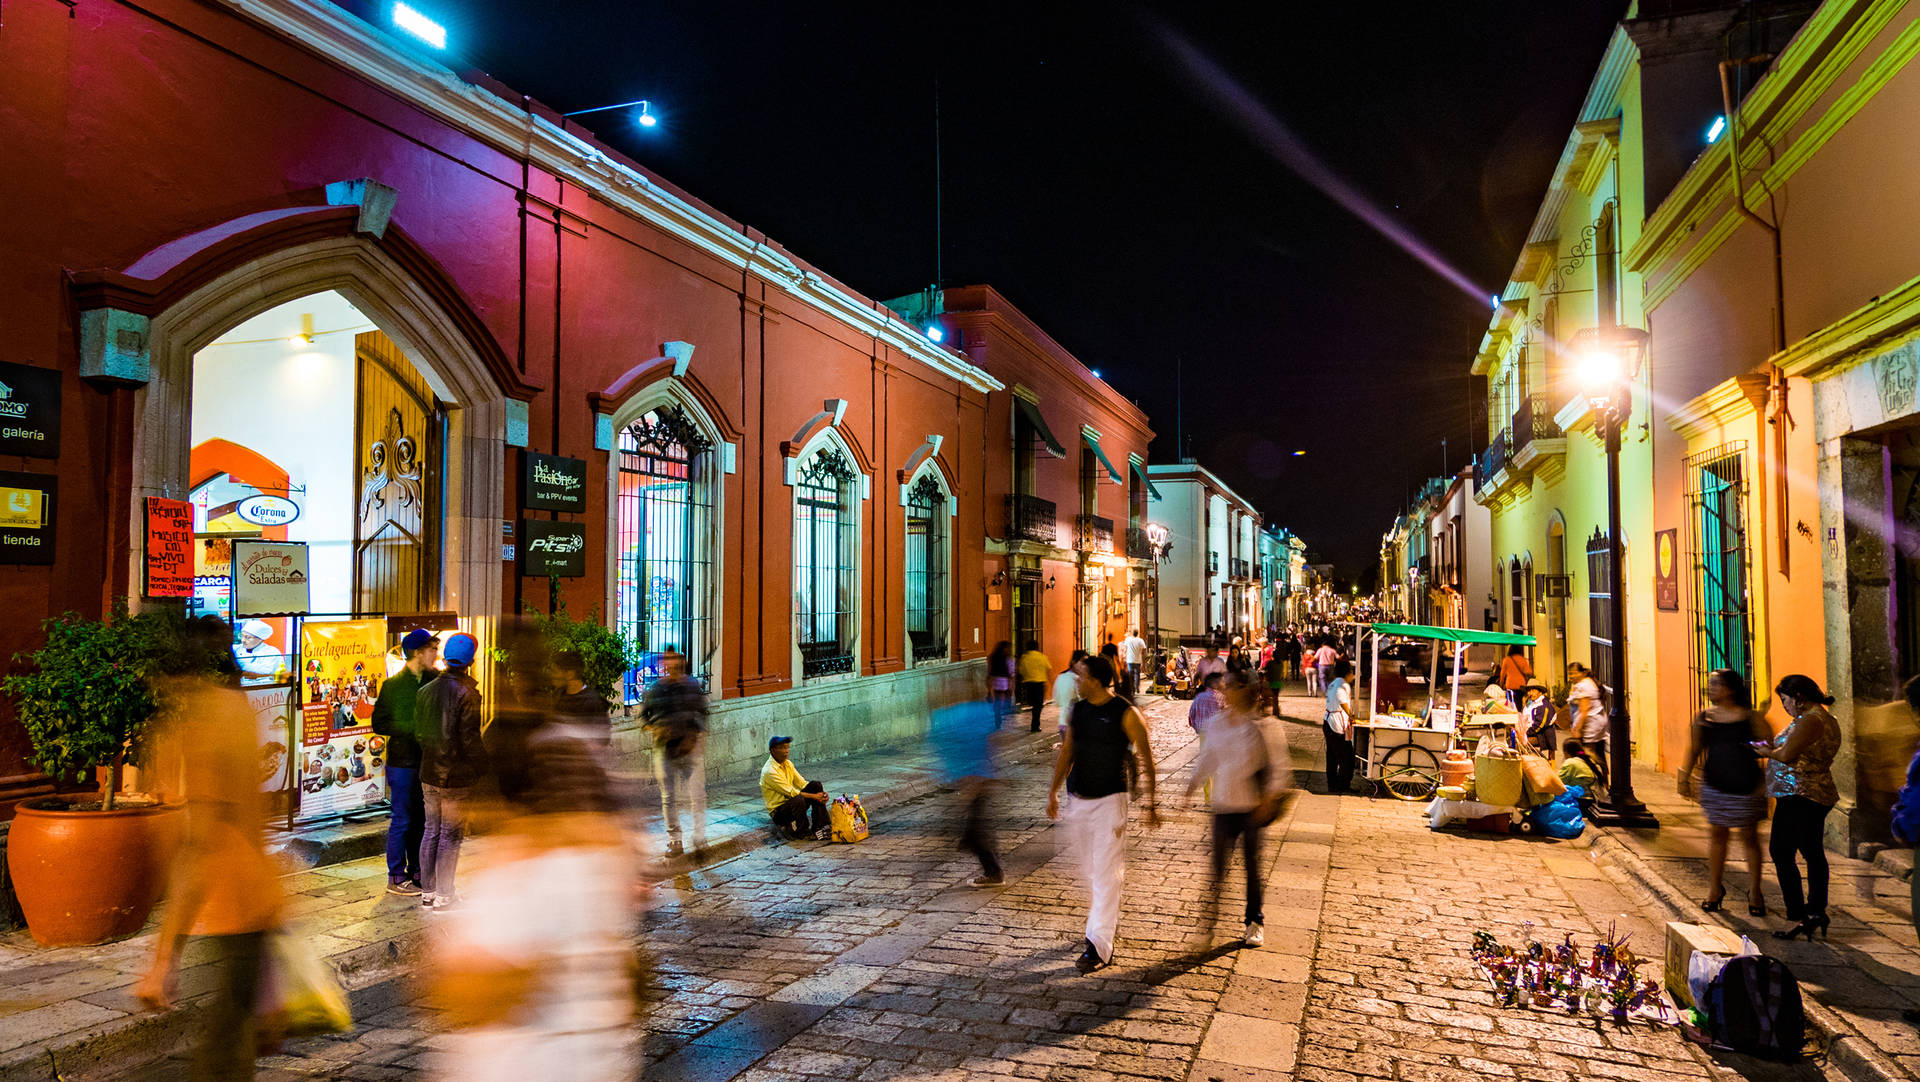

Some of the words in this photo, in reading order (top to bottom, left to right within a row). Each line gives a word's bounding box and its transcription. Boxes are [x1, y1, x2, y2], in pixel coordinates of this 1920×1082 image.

[250, 505, 286, 518] Corona
[4, 535, 41, 546] tienda
[547, 534, 569, 542] Super
[159, 552, 185, 564] VIVO
[255, 564, 281, 574] Dulces
[249, 573, 286, 584] Saladas
[304, 641, 367, 661] Guelaguetza
